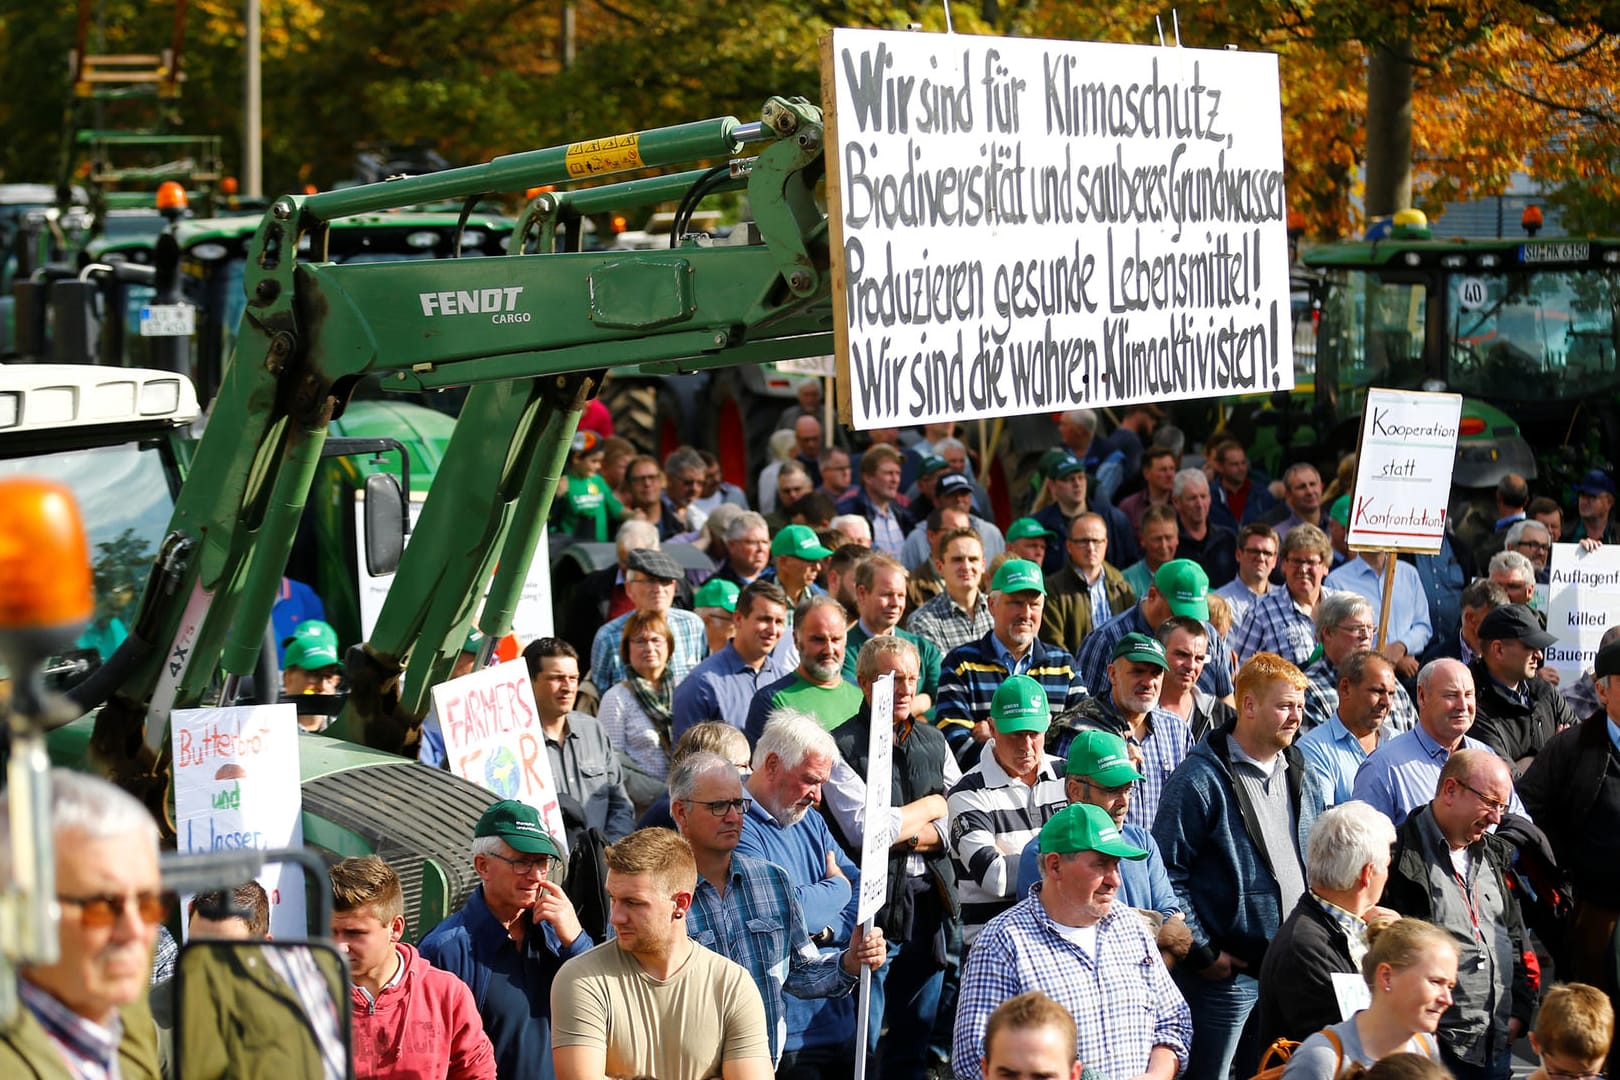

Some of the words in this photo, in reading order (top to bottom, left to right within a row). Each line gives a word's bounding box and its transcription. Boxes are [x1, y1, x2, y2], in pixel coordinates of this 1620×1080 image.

[842, 42, 915, 134] Wir
[916, 49, 973, 134] sind
[981, 48, 1026, 134] für
[1043, 51, 1233, 149] Klimaschutz,
[845, 138, 1028, 229] Biodiversität
[1030, 142, 1073, 225] und
[1076, 142, 1168, 224] sauberes
[1169, 142, 1284, 242] Grundwasser
[845, 236, 984, 333] Produzieren
[991, 237, 1098, 345] gesunde
[1107, 226, 1260, 314] Lebensmittel!
[1464, 282, 1482, 303] 40
[419, 287, 524, 316] FENDT
[492, 312, 531, 324] CARGO
[852, 336, 907, 420] Wir
[909, 328, 965, 418] sind
[969, 324, 1007, 408] die
[1009, 318, 1098, 407] wahren
[1103, 299, 1281, 402] Klimaaktivisten!
[1372, 406, 1455, 440] Kooperation
[1380, 458, 1416, 478] statt
[1355, 496, 1446, 528] Konfrontation!
[1567, 611, 1606, 626] killed
[1546, 647, 1597, 661] Bauern
[446, 677, 533, 749] FARMERS
[211, 780, 241, 810] und
